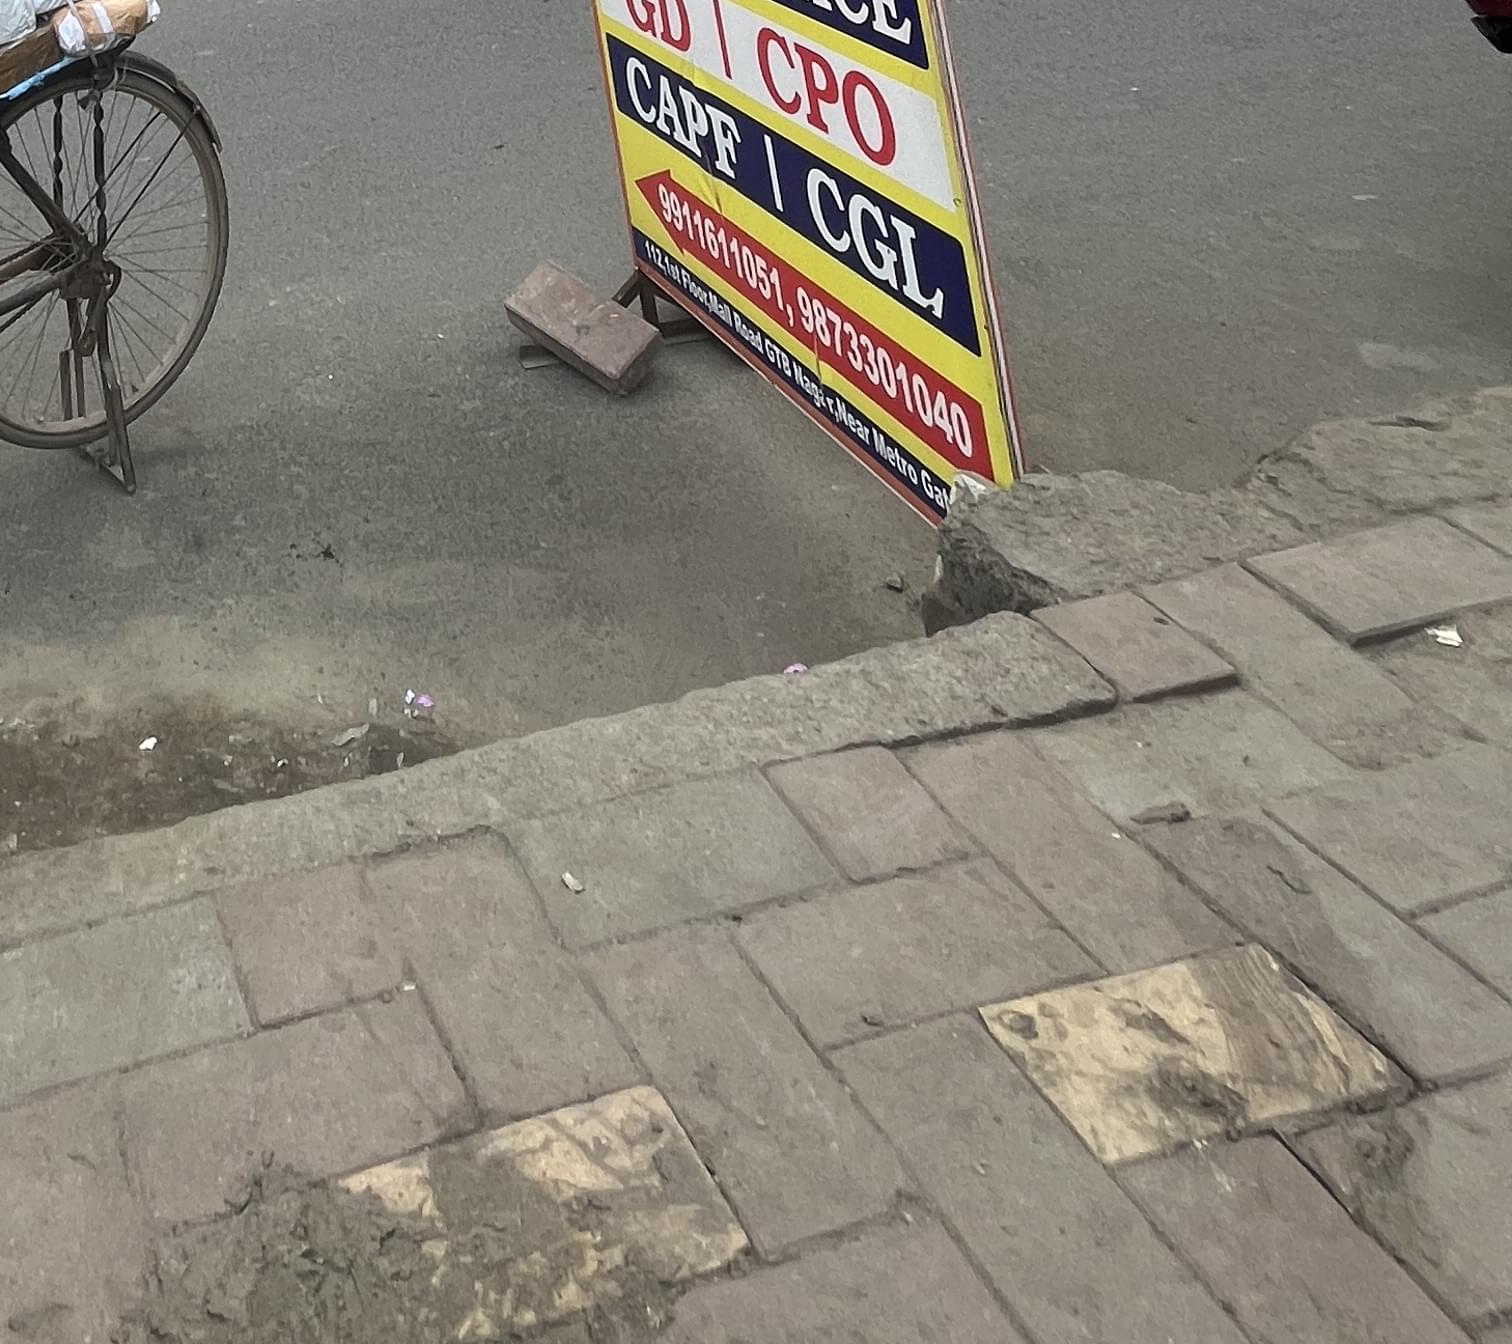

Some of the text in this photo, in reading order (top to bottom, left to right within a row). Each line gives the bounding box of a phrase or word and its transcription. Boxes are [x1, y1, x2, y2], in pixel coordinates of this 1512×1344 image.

[624, 56, 945, 321] CAPF CGL
[756, 27, 897, 167] CPO
[657, 182, 975, 459] 9911611051, 9873301040
[733, 312, 919, 486] Road GTB Metro
